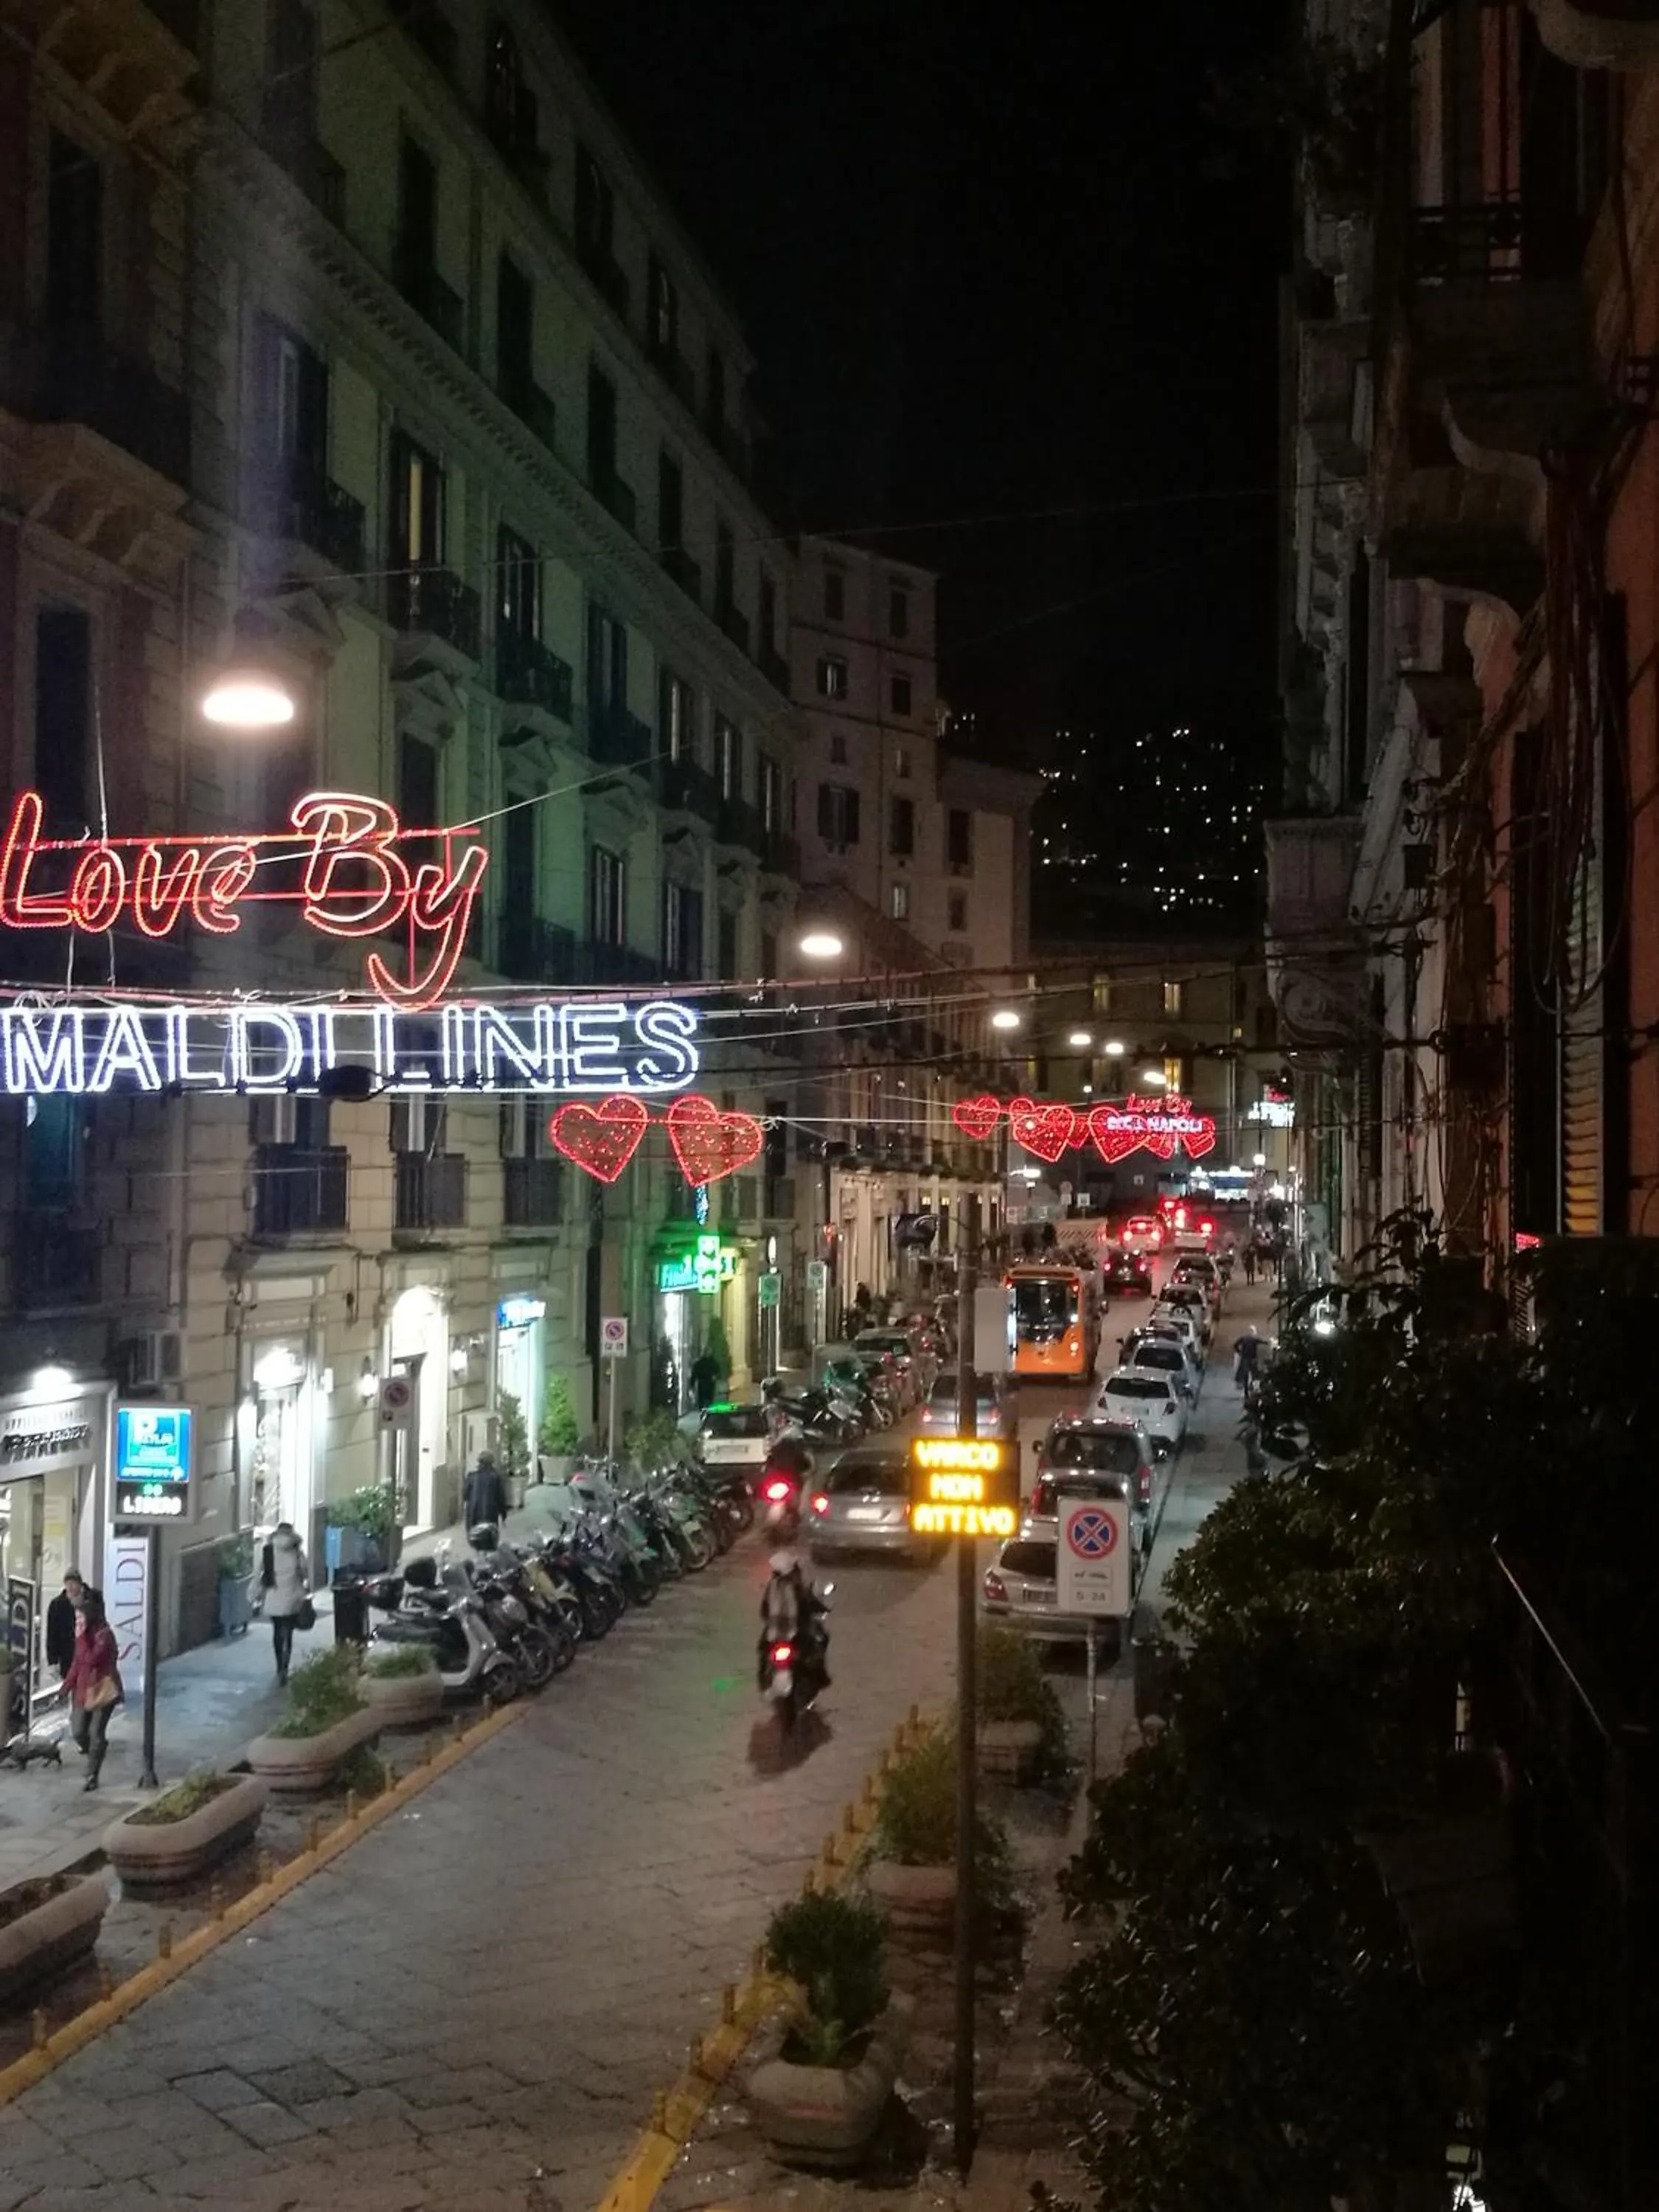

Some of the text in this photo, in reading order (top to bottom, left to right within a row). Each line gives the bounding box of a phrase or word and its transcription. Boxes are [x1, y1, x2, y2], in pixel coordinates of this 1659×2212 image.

[0, 791, 488, 1012] Love By
[1147, 1116, 1203, 1133] NAPOLI
[915, 1440, 999, 1470] VARCO
[930, 1472, 983, 1500] NON
[914, 1503, 1015, 1534] ATTIVO
[115, 1546, 145, 1661] SALDI
